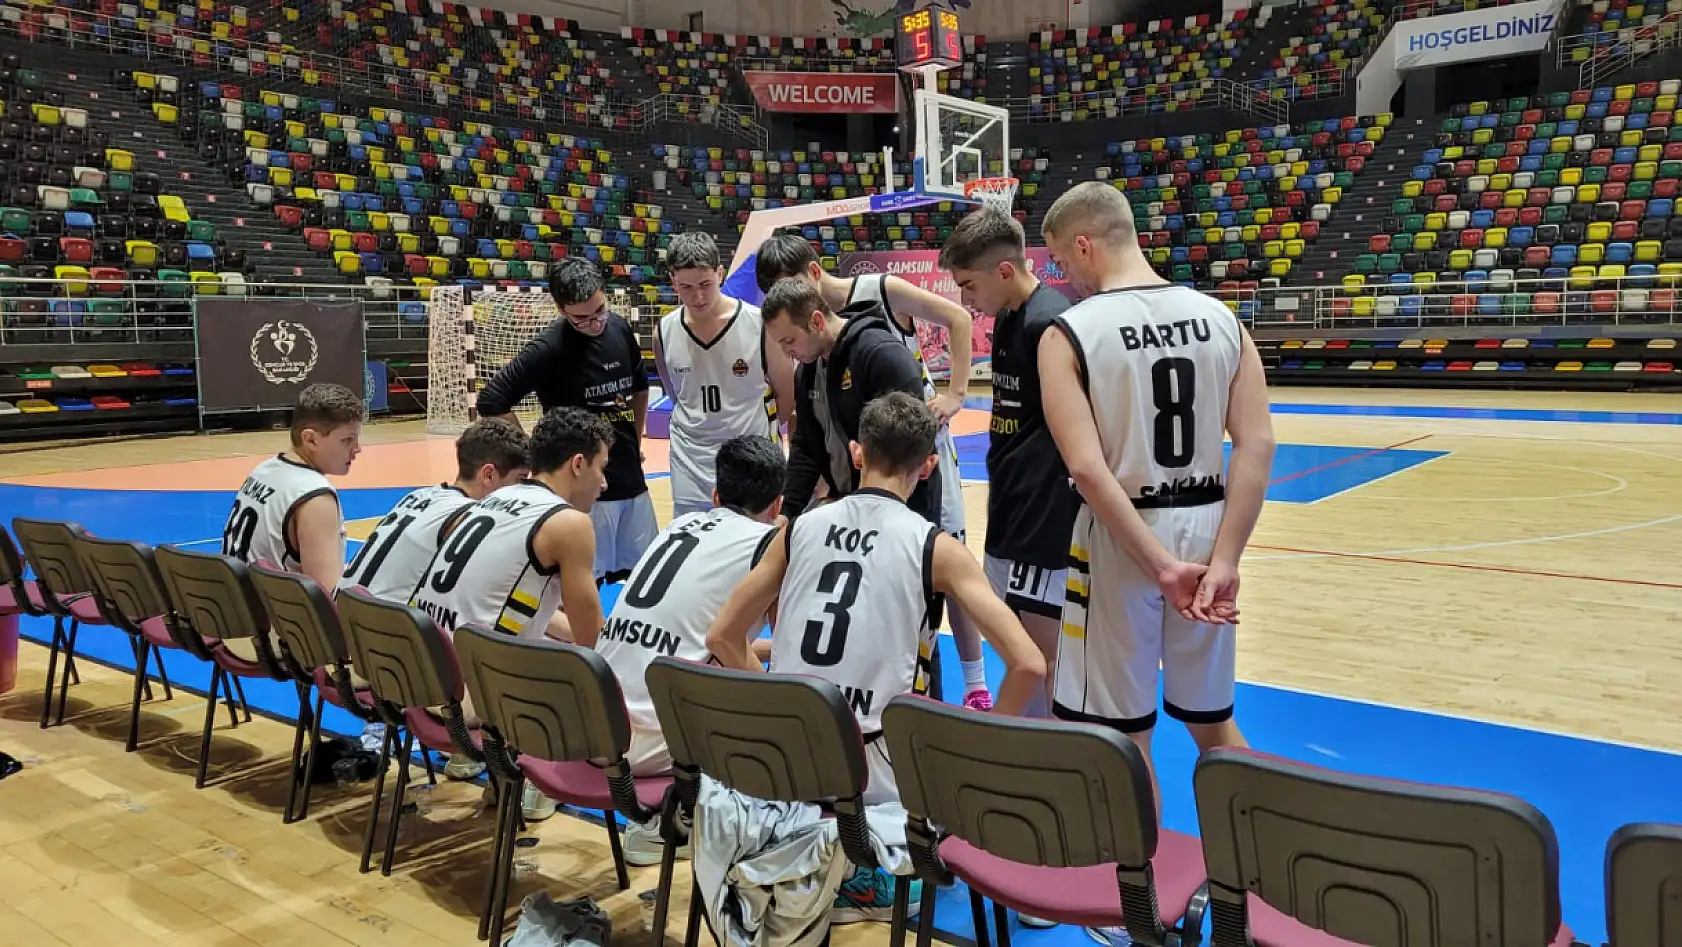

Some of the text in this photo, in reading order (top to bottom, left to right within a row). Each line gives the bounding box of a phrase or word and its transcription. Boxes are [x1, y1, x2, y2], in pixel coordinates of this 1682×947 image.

[904, 11, 929, 32] 5:35
[1409, 13, 1555, 51] HOŞGELDİNİZ
[916, 31, 929, 59] 5
[767, 83, 875, 105] WELCOME
[886, 260, 933, 275] SAMSUN
[1119, 318, 1212, 351] BARTU
[701, 384, 721, 413] 10
[1151, 357, 1196, 468] 8
[824, 523, 880, 557] KOÇ
[625, 531, 700, 611] 0
[1009, 560, 1042, 596] 91
[800, 560, 864, 667] 3
